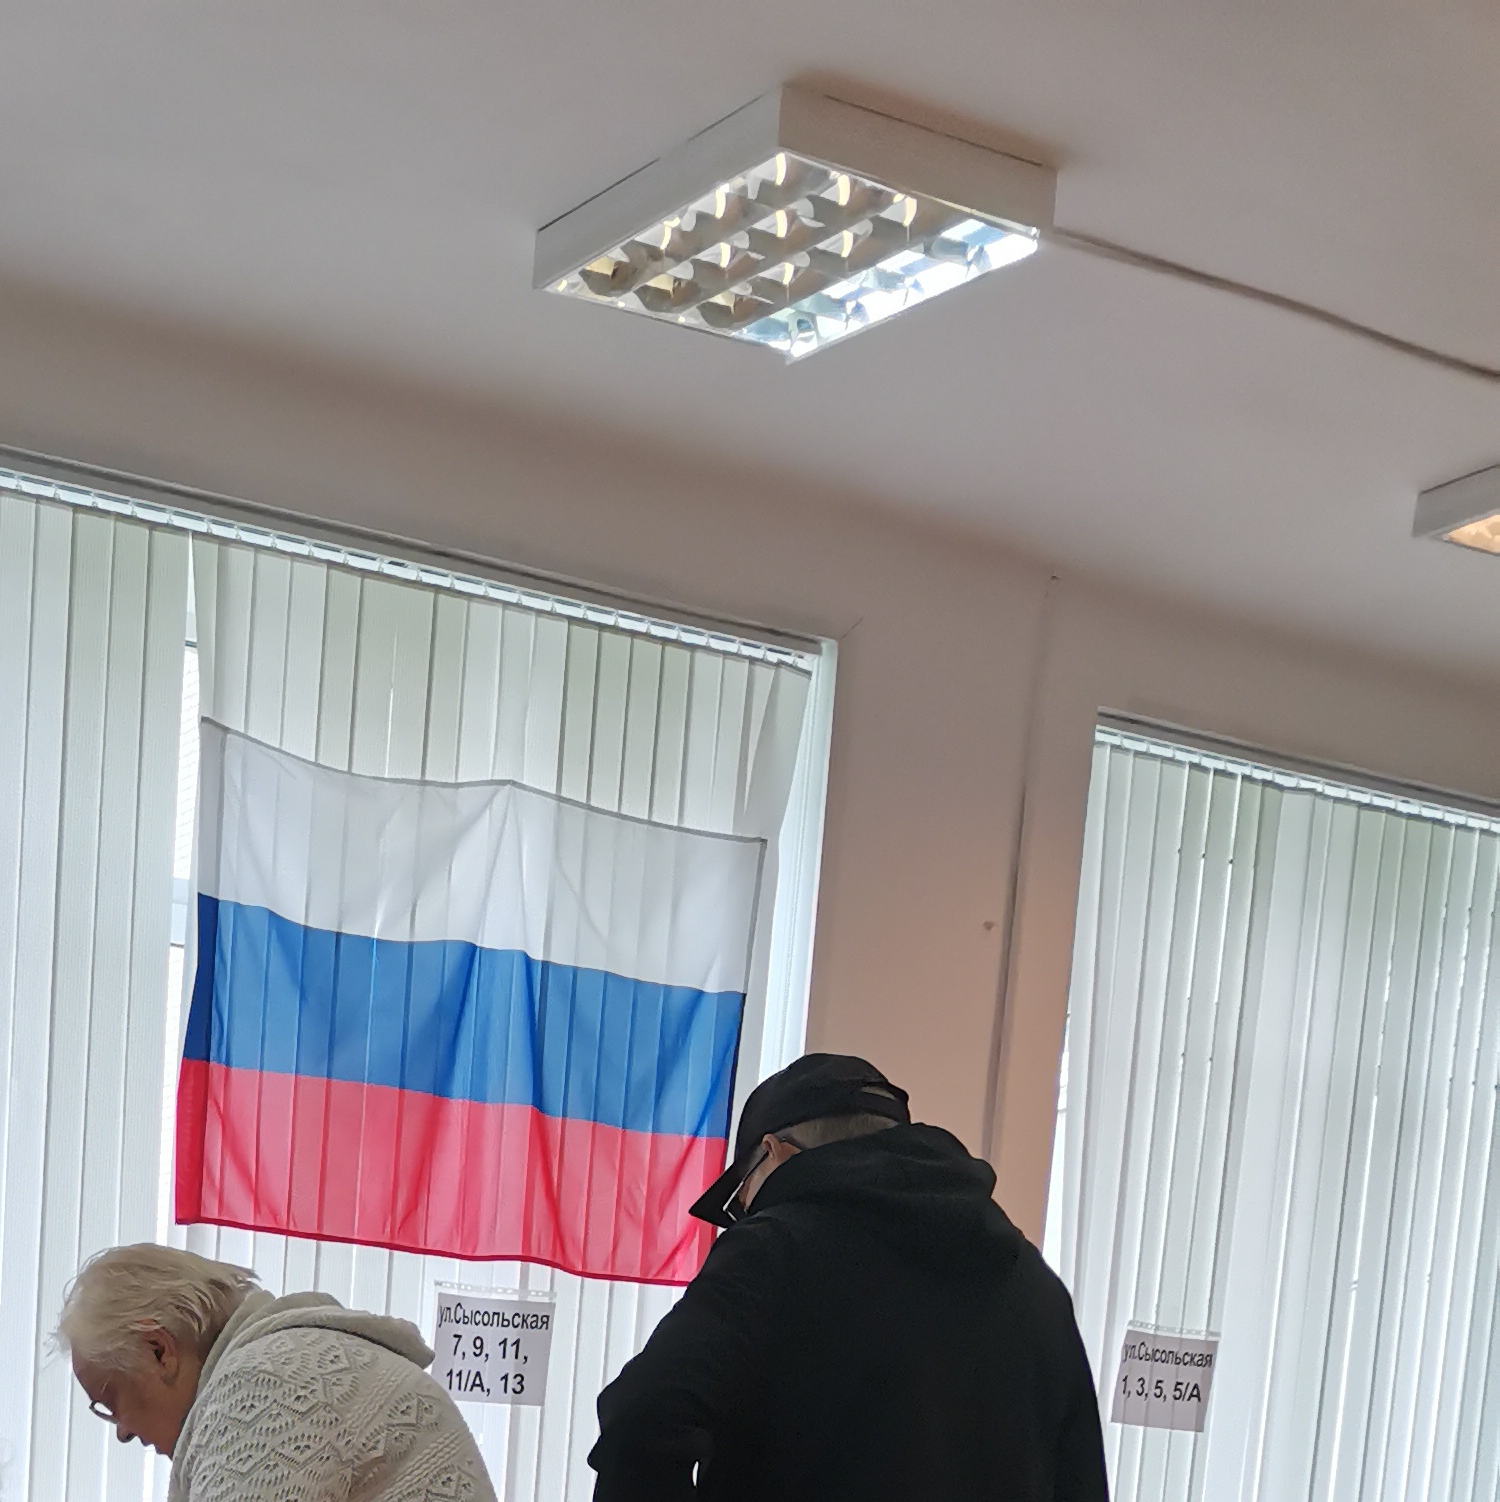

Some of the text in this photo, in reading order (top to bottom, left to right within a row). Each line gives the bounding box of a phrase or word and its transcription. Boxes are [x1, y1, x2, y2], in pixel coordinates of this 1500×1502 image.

[452, 1333, 528, 1365] 7, 9, 11,
[446, 1368, 525, 1397] 11/А, 13
[1121, 1374, 1202, 1404] 1, 3, 5, 5/А
